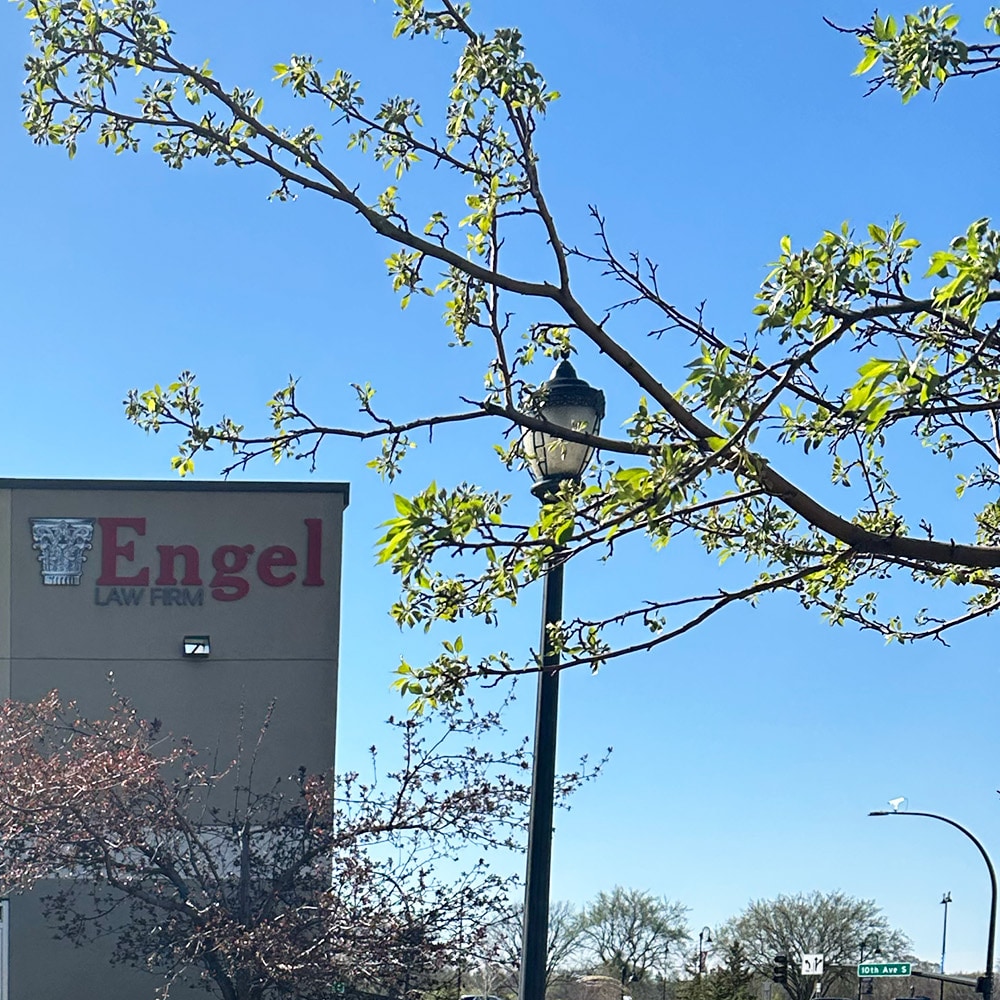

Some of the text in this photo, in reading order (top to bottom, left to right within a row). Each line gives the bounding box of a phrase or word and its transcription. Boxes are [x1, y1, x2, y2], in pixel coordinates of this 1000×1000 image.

[96, 517, 325, 601] Engel
[94, 587, 204, 606] LAW FIRM
[861, 965, 907, 974] 10th Ave S
